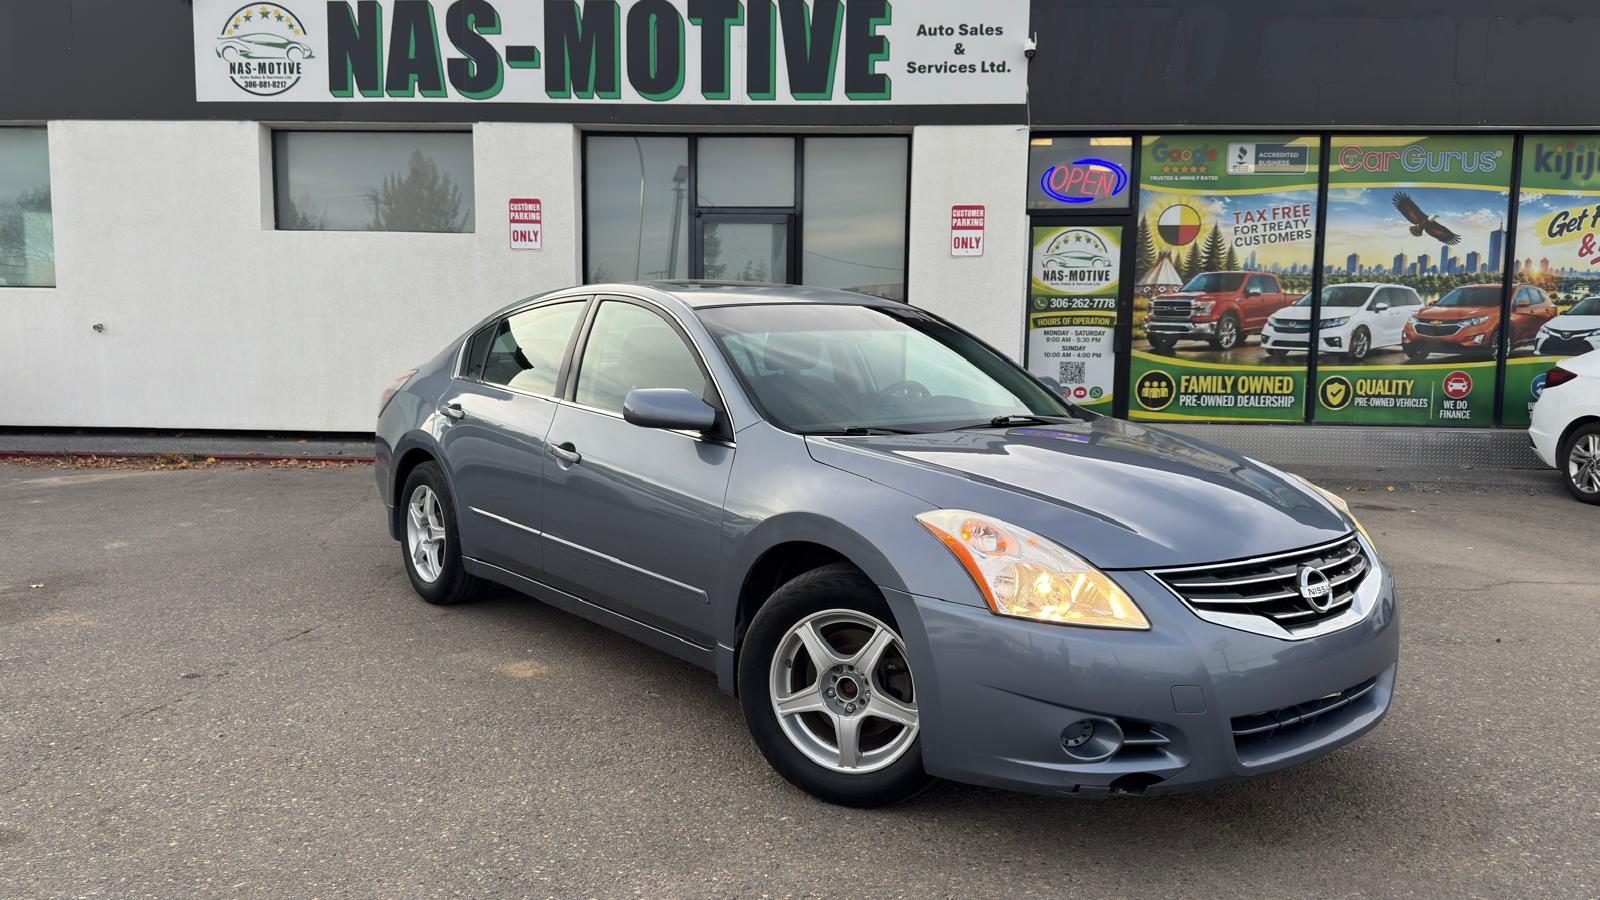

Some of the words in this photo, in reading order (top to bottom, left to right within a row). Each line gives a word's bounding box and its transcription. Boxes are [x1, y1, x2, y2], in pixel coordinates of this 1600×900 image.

[916, 24, 955, 36] Auto
[958, 23, 1004, 36] Sales
[327, 0, 892, 101] NAS-MOTIVE
[953, 42, 966, 55] &
[229, 62, 302, 75] NAS-MOTIVE
[906, 61, 977, 74] Services
[981, 60, 1011, 73] Ltd.
[244, 80, 287, 89] 306-881-8217
[1535, 142, 1600, 180] kijij
[1050, 165, 1115, 197] OPEN
[510, 203, 541, 211] CUSTOMER
[952, 209, 984, 217] CUSTOMER
[510, 212, 541, 220] PARKING
[1232, 209, 1267, 225] TAX
[1271, 204, 1311, 220] FREE
[952, 218, 984, 226] PARKING
[1233, 224, 1258, 236] FOR
[1261, 218, 1309, 233] TREATY
[1547, 208, 1588, 238] Get
[512, 230, 539, 242] ONLY
[953, 236, 981, 249] ONLY
[1234, 229, 1312, 248] CUSTOMERS
[1578, 233, 1596, 257] &
[1042, 270, 1111, 281] NAS-MOTIVE
[1050, 298, 1116, 308] 306-262-7778
[1037, 318, 1061, 326] HOURS
[1062, 317, 1071, 325] OF
[1072, 317, 1110, 325] OPERATION
[1180, 375, 1234, 394] FAMILY
[1237, 376, 1294, 394] OWNED
[1356, 379, 1414, 396] QUALITY
[1179, 395, 1234, 407] PRE-OWNED
[1237, 395, 1295, 408] DEALERSHIP
[1354, 397, 1394, 407] PRE-OWNED
[1396, 398, 1428, 408] VEHICLES
[1443, 400, 1454, 409] WE
[1456, 401, 1468, 409] DO
[1439, 410, 1471, 419] FINANCE
